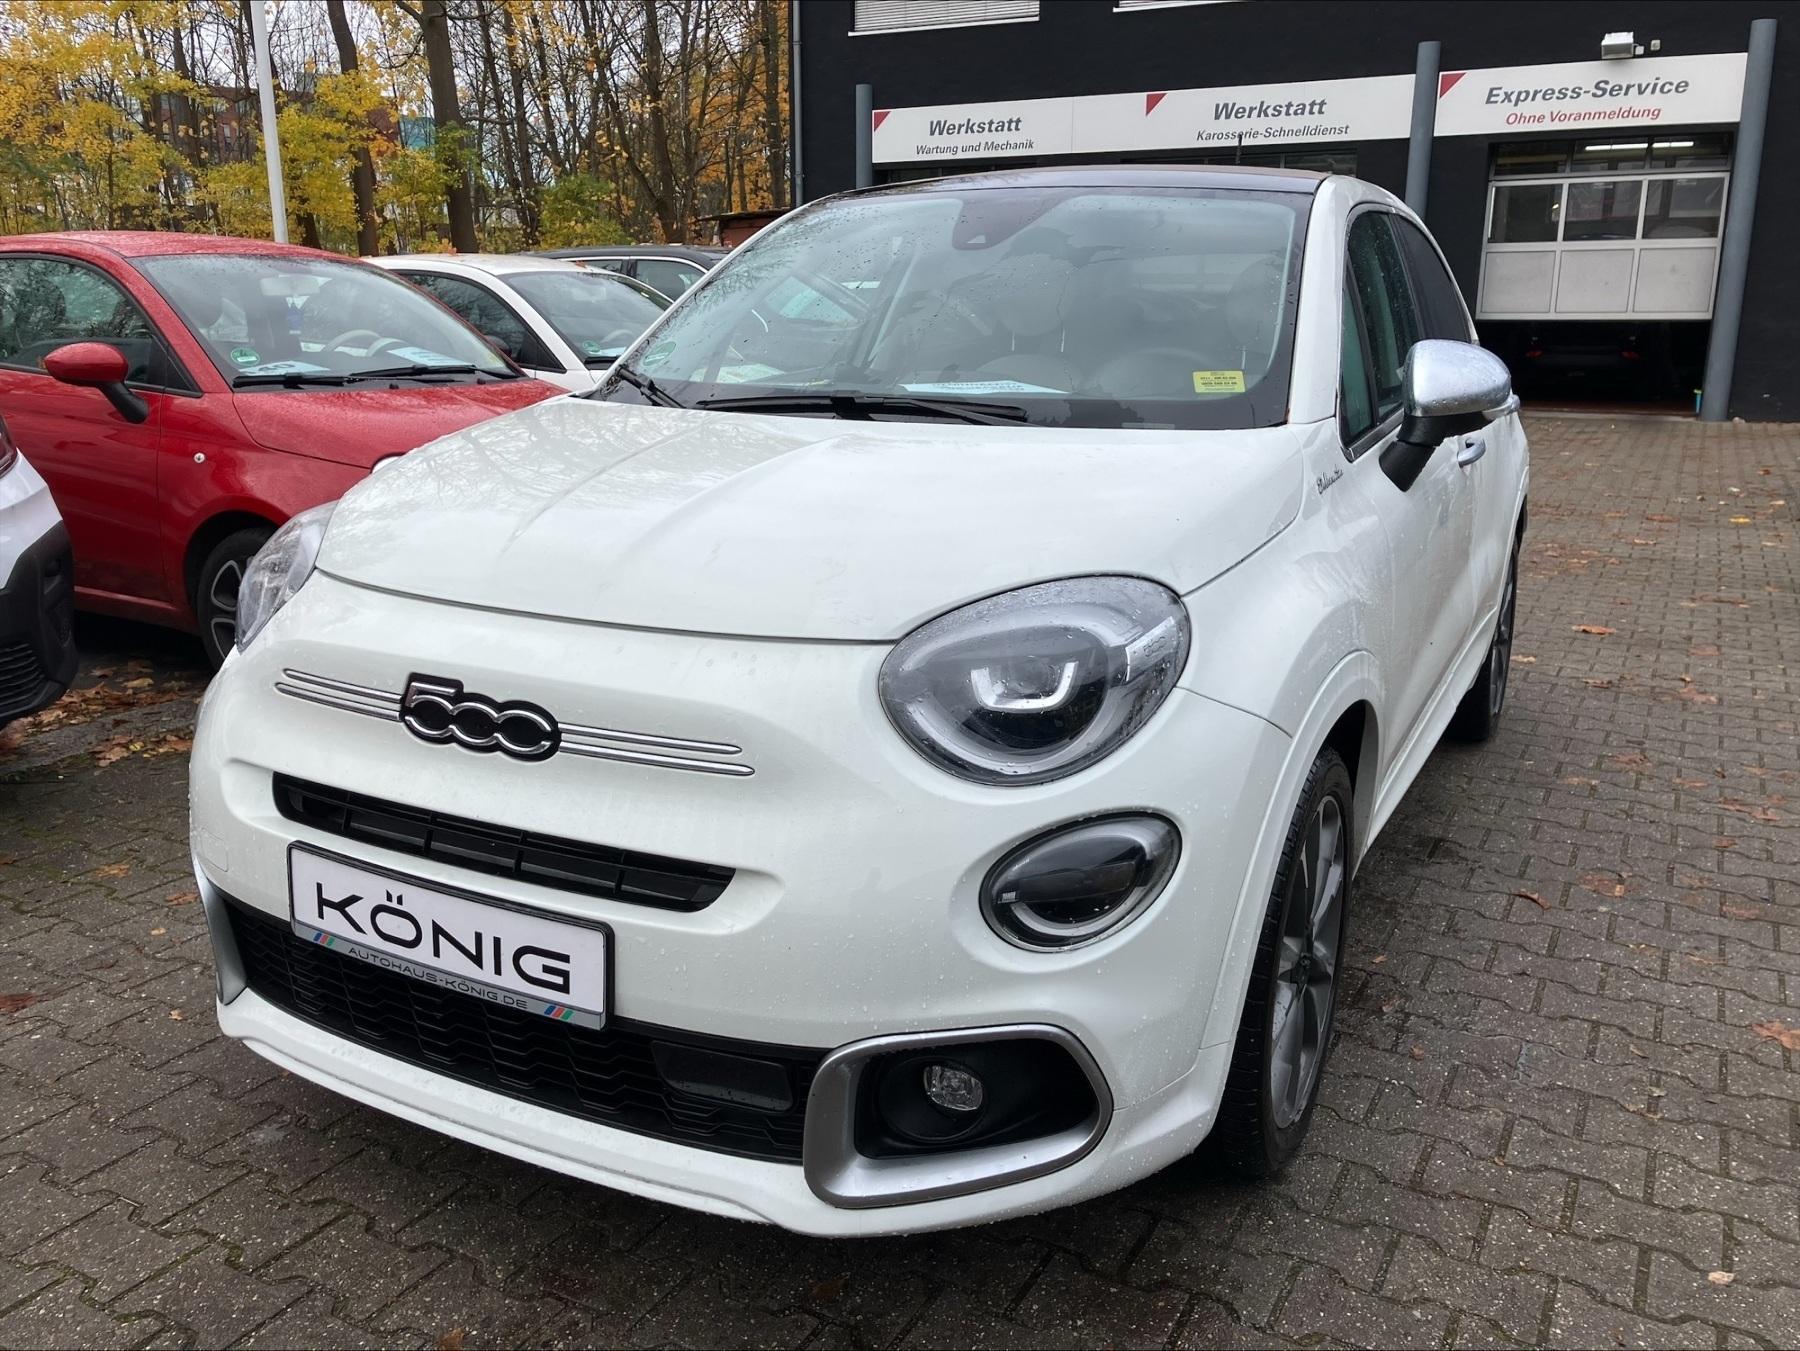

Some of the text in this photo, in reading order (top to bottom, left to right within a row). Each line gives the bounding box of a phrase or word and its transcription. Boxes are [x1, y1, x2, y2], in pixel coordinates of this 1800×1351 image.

[1485, 76, 1689, 107] Express-Service
[1213, 98, 1328, 121] Werkstatt
[1505, 106, 1662, 126] Ohne Voranmeldung
[928, 116, 1022, 137] Werkstatt
[916, 138, 1035, 156] Wartung und Mechanik
[402, 673, 561, 762] 500
[315, 881, 571, 995] KÖNIG
